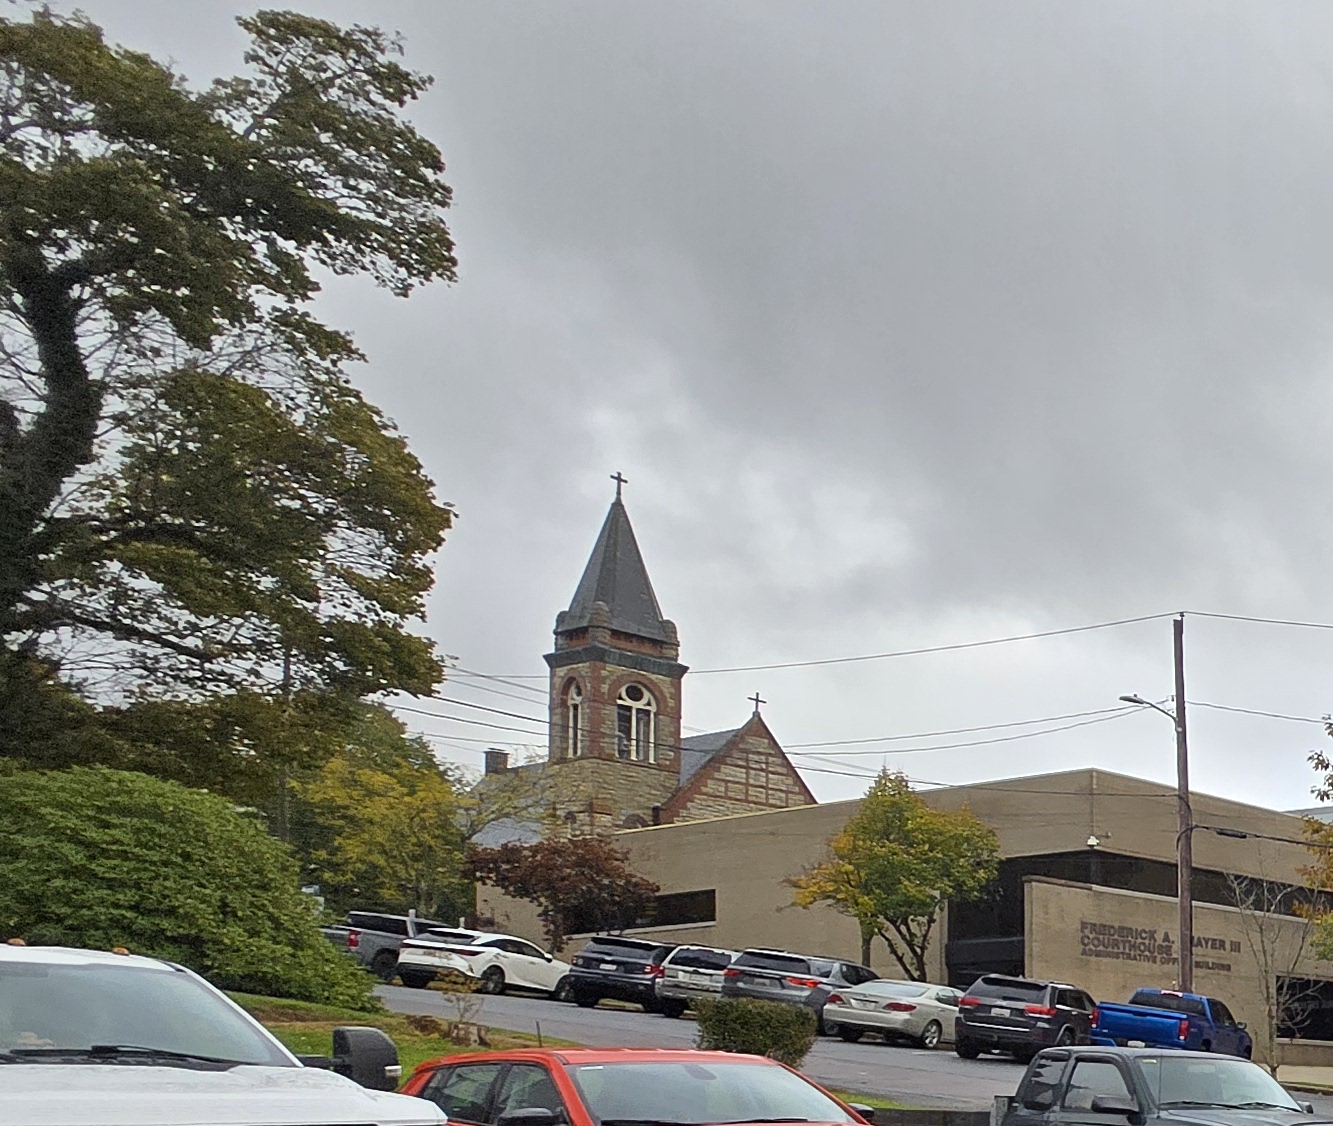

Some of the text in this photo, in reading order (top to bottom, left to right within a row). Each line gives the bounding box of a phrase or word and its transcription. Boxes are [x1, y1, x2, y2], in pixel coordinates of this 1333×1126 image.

[1081, 921, 1157, 943] FREDERICK
[1162, 931, 1175, 945] A.
[1230, 940, 1242, 954] III
[1081, 935, 1173, 957] COURTHOUSE
